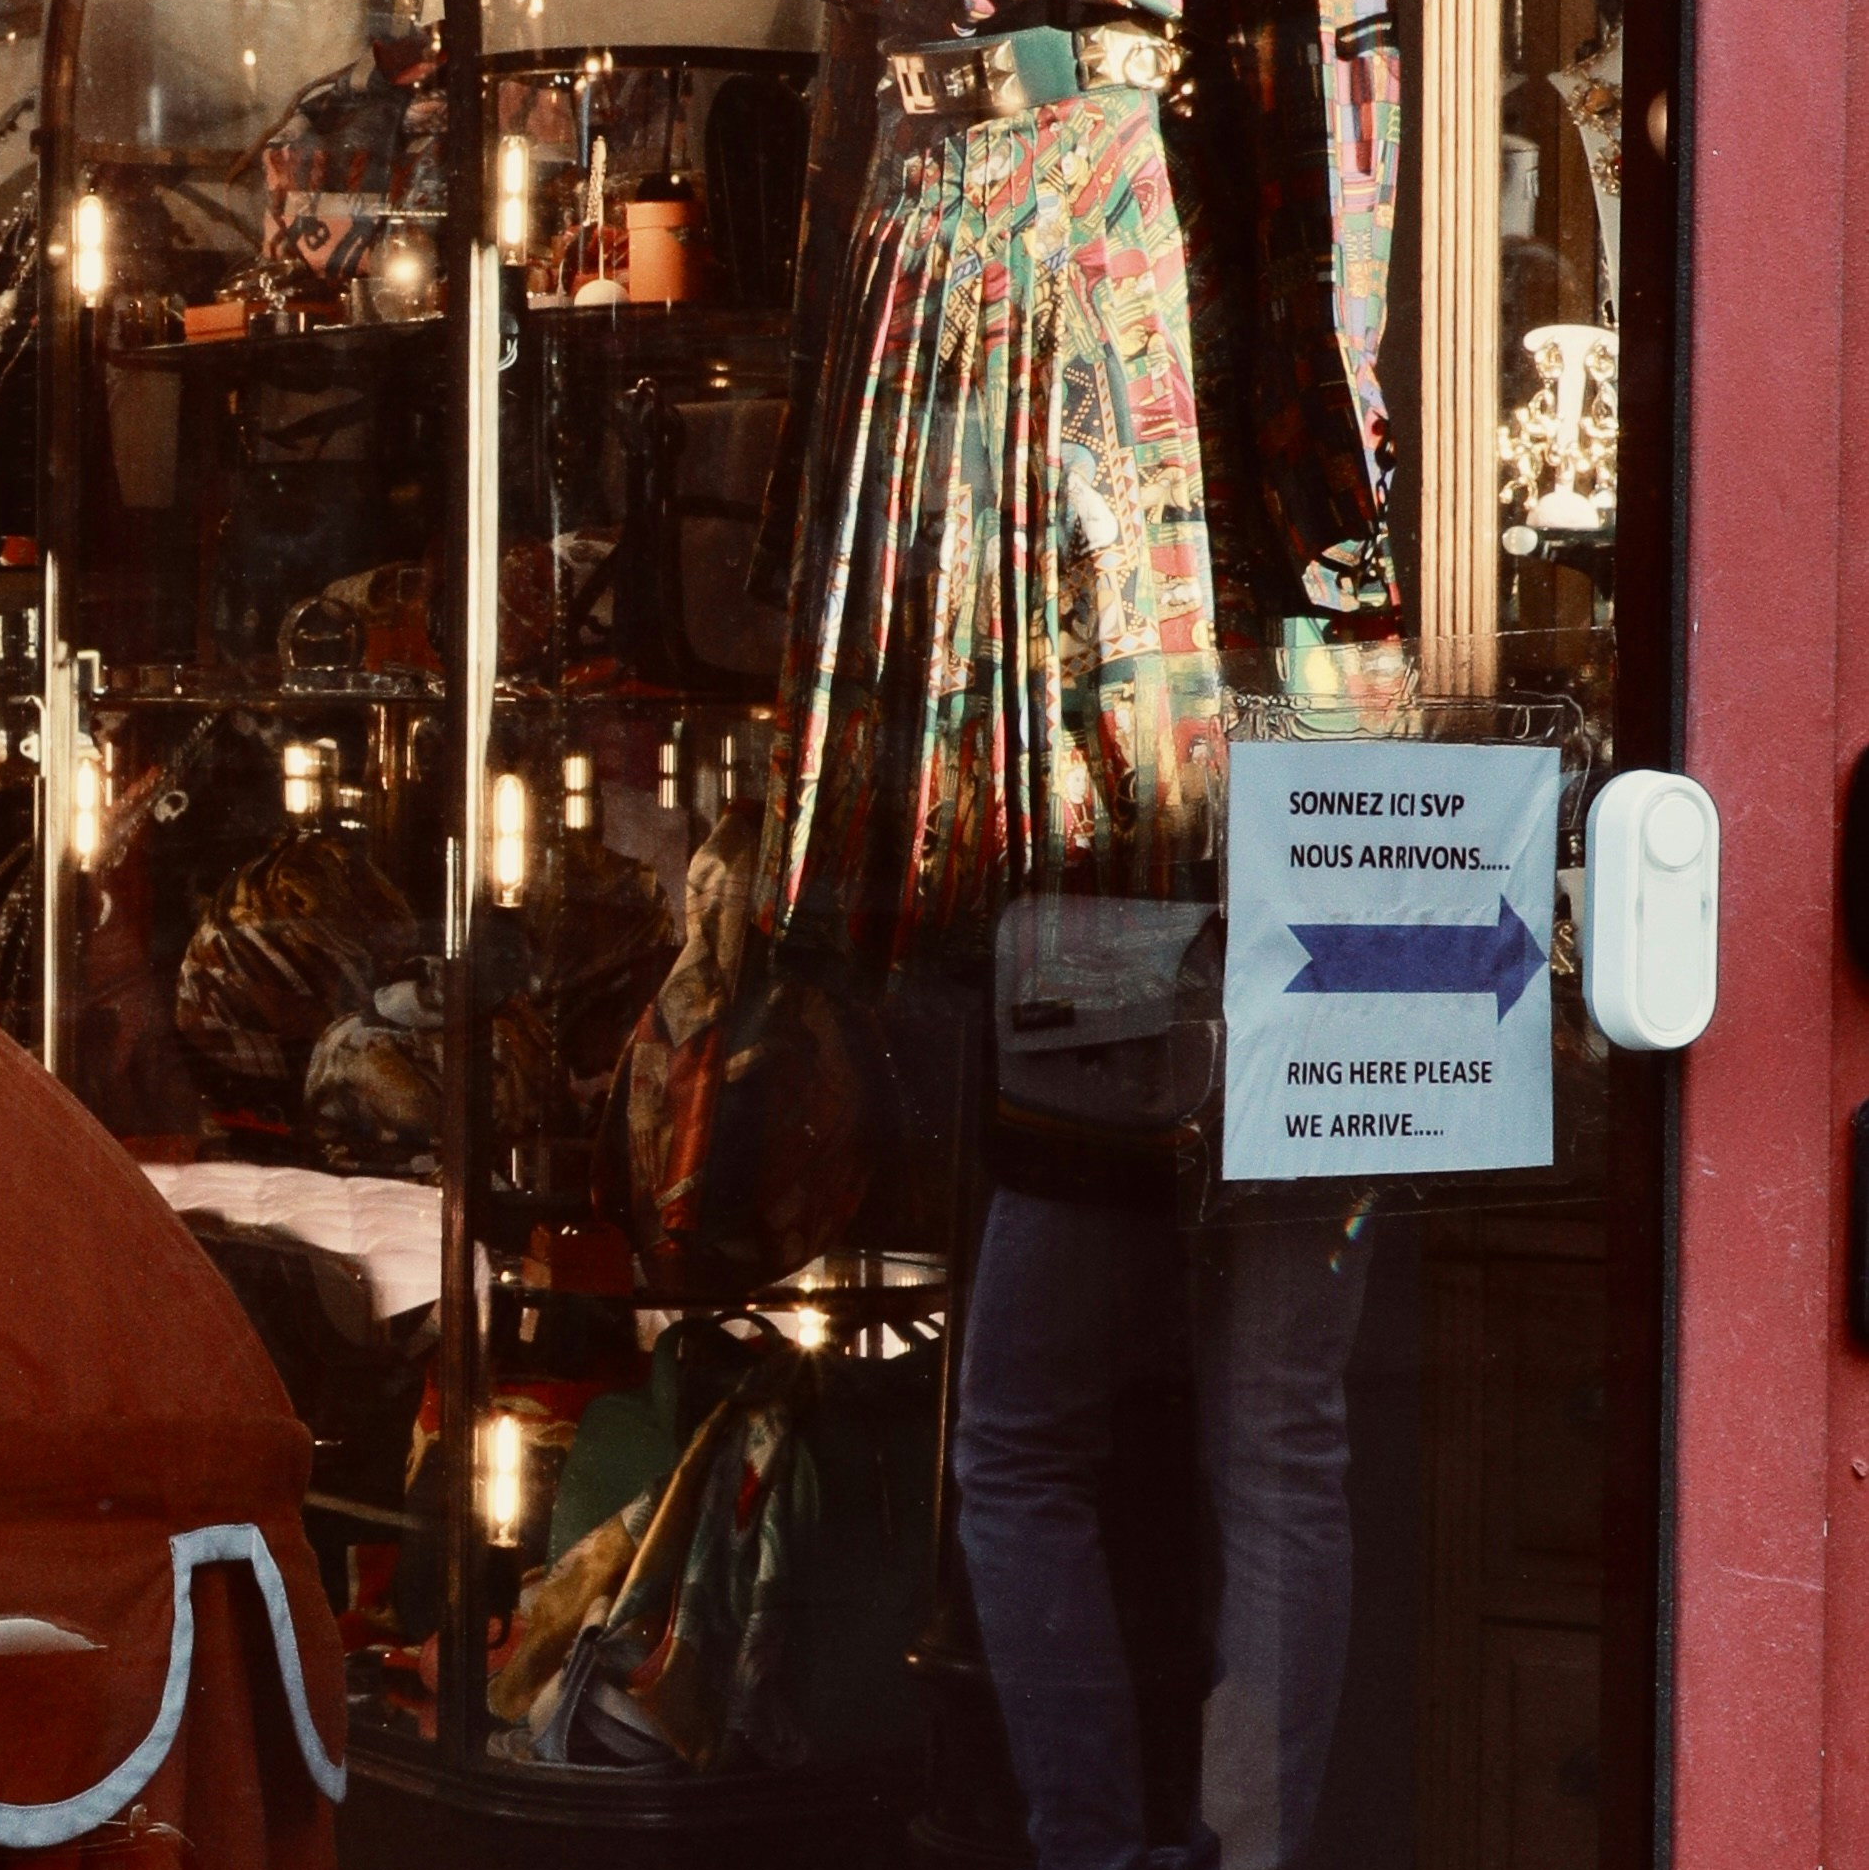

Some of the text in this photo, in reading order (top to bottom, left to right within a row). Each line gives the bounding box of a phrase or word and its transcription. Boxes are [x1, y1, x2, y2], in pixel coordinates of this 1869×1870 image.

[1289, 791, 1465, 818] SONNEZ ICI SVP
[1290, 844, 1353, 869] NOUS
[1287, 1060, 1493, 1085] RING HERE PLEASE
[1285, 1114, 1323, 1138] WE
